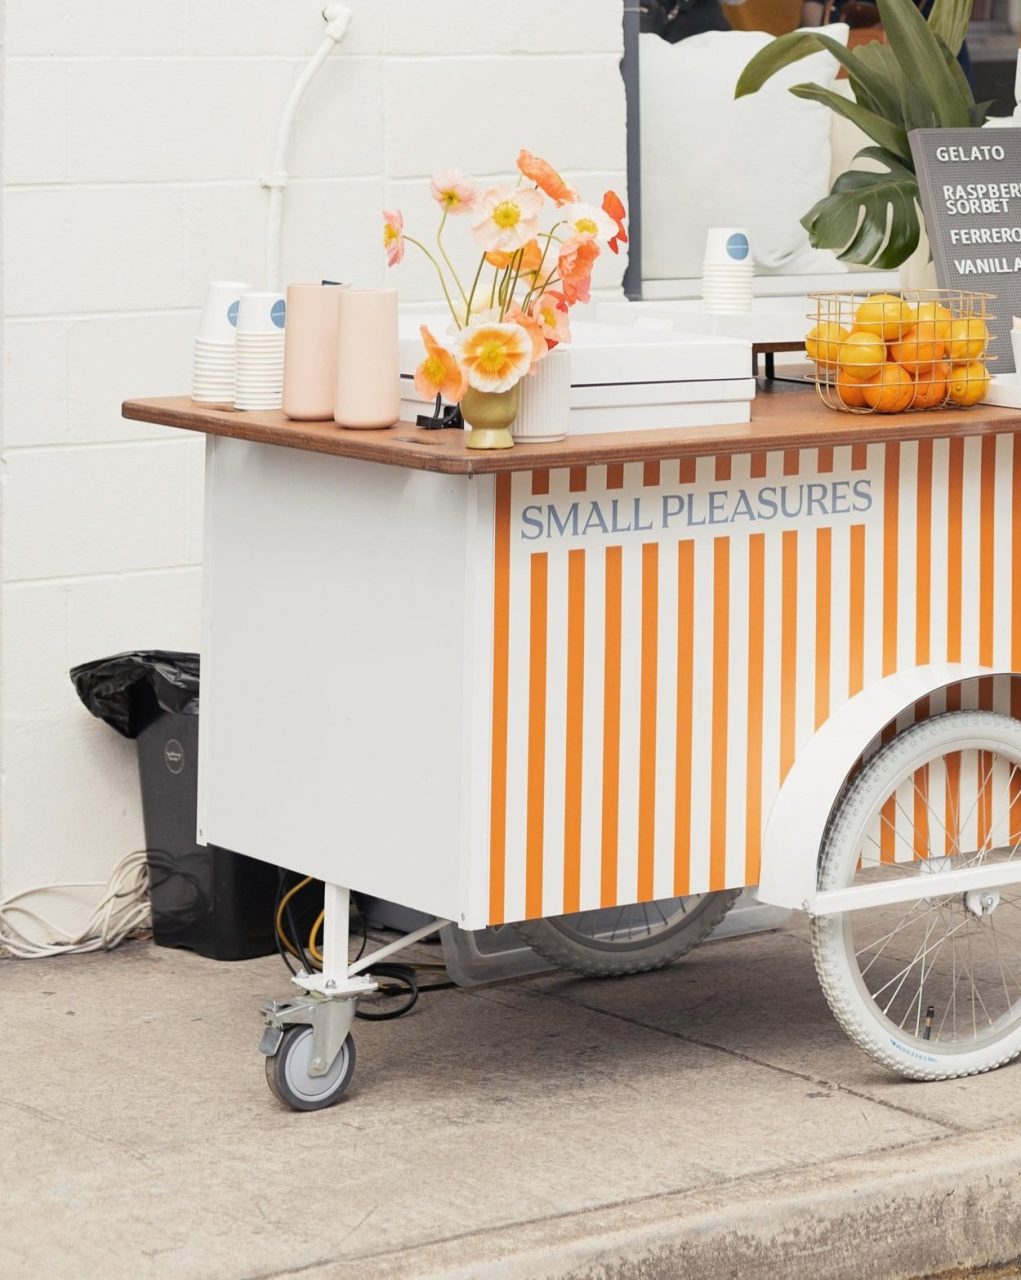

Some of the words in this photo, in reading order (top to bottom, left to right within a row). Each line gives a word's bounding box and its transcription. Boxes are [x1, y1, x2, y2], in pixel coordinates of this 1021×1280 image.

[936, 145, 1005, 162] GELATO
[946, 198, 1010, 215] SORBET
[520, 497, 653, 540] SMALL
[662, 479, 873, 528] PLEASURES
